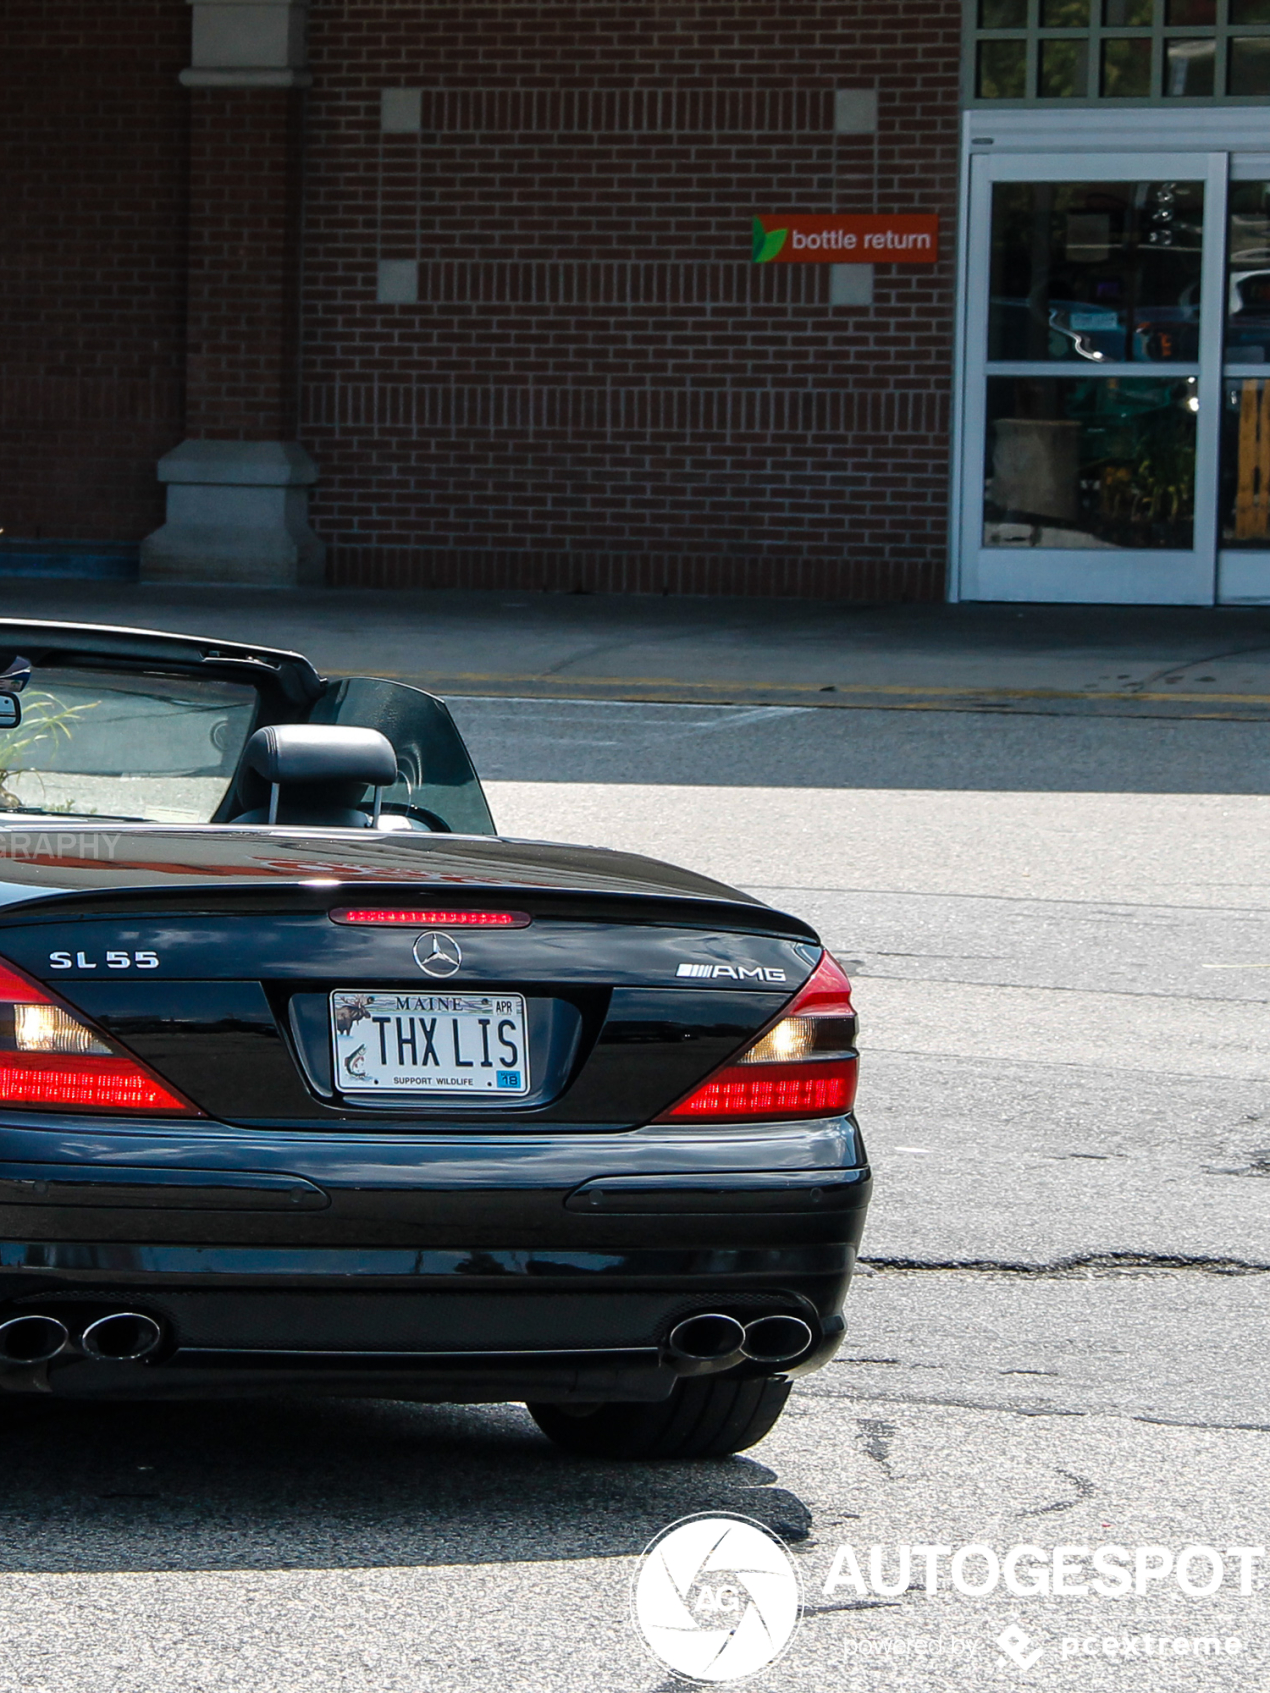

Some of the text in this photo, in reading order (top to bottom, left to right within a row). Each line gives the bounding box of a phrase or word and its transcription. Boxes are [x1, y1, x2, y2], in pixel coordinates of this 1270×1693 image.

[792, 229, 931, 249] bottle return
[49, 951, 160, 969] SL 55
[711, 965, 787, 982] AMG
[395, 996, 464, 1011] MAINE
[496, 1001, 513, 1013] APR
[372, 1017, 518, 1068] THX LIS
[393, 1076, 474, 1086] SUPPORT WILDLIFE
[502, 1075, 518, 1086] 18
